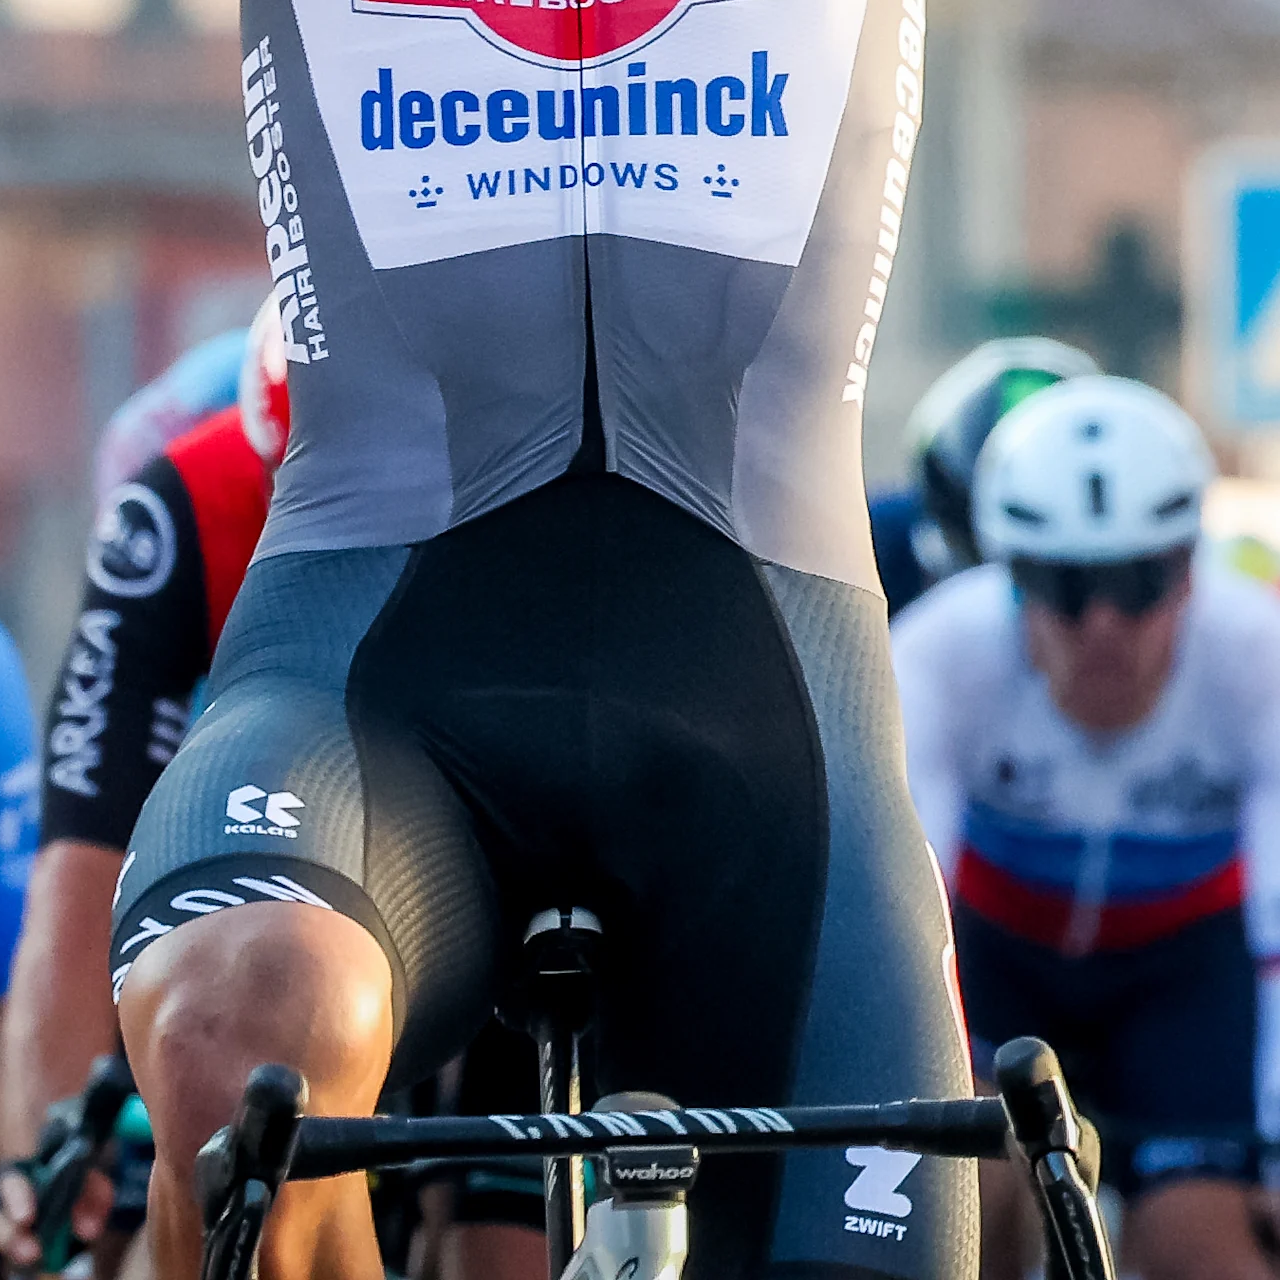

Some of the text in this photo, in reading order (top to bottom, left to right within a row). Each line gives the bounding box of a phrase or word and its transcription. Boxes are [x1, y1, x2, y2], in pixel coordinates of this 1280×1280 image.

[360, 51, 790, 151] deceuninck
[467, 162, 680, 200] WINDOWS
[240, 46, 311, 365] Alpecin
[295, 267, 330, 363] HAIR
[489, 1107, 795, 1141] CANYON
[616, 1163, 694, 1181] wahoo
[844, 1216, 908, 1242] ZWIFT
